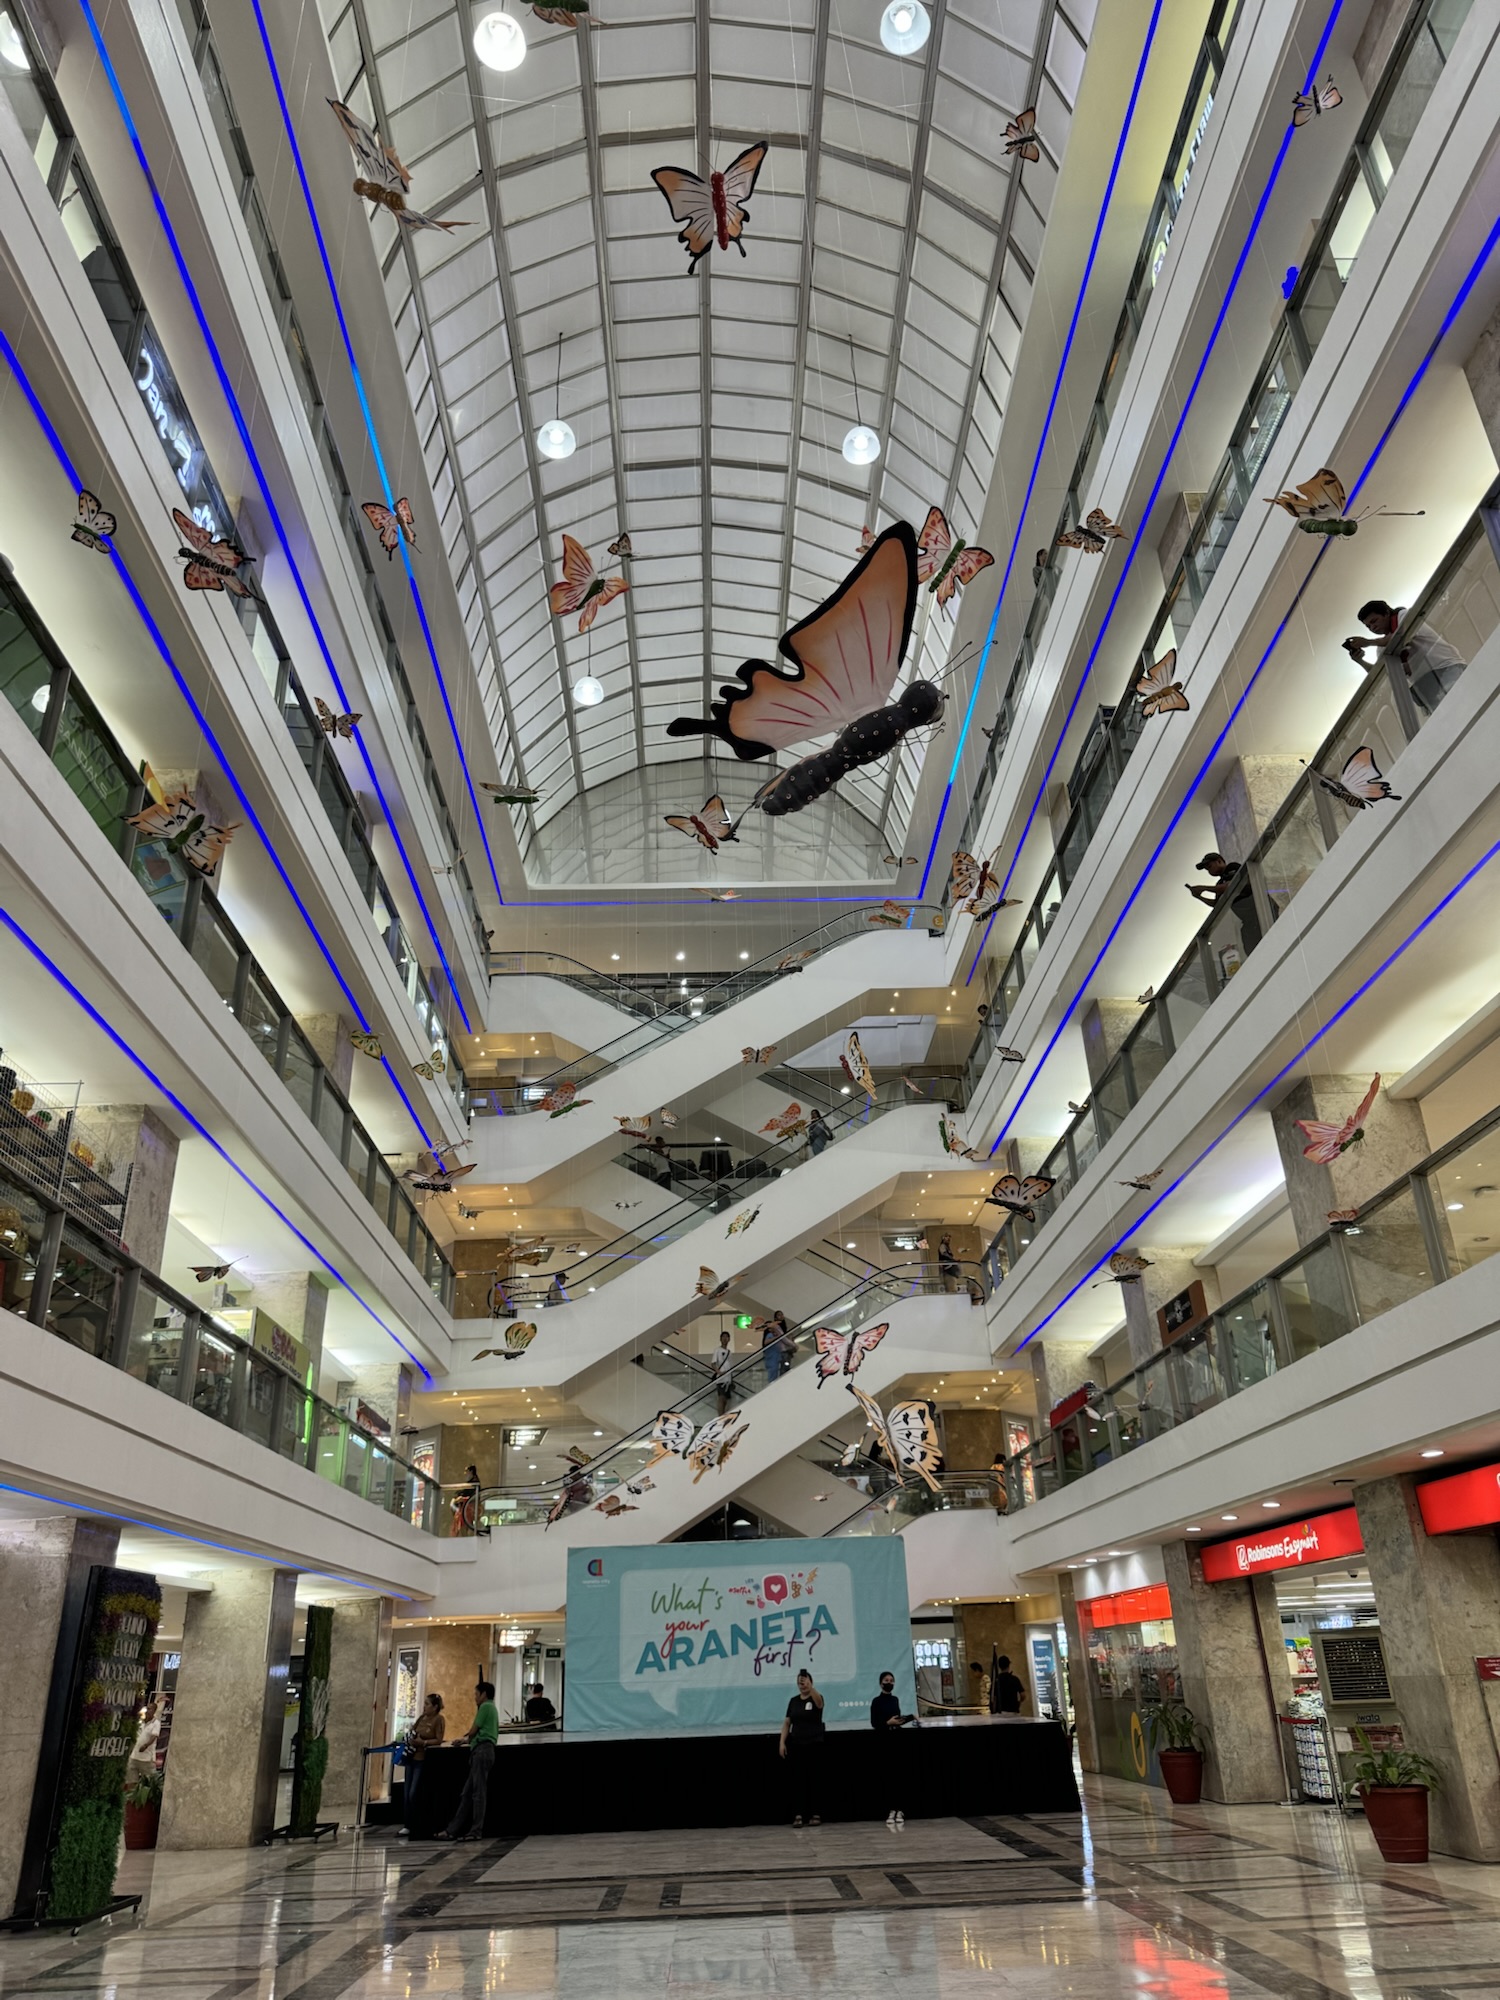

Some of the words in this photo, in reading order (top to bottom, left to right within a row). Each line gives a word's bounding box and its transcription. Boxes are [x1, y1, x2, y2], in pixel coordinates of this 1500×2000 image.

[1247, 1543, 1284, 1563] Robinsons
[1283, 1531, 1319, 1562] Easymart
[651, 1577, 724, 1615] What's
[113, 1637, 142, 1660] EVERY
[635, 1604, 839, 1675] ARANETA
[660, 1618, 710, 1659] your
[915, 1642, 949, 1656] BOOK
[110, 1710, 122, 1732] IS
[1357, 1713, 1380, 1721] iwata
[90, 1736, 131, 1757] HERSELF
